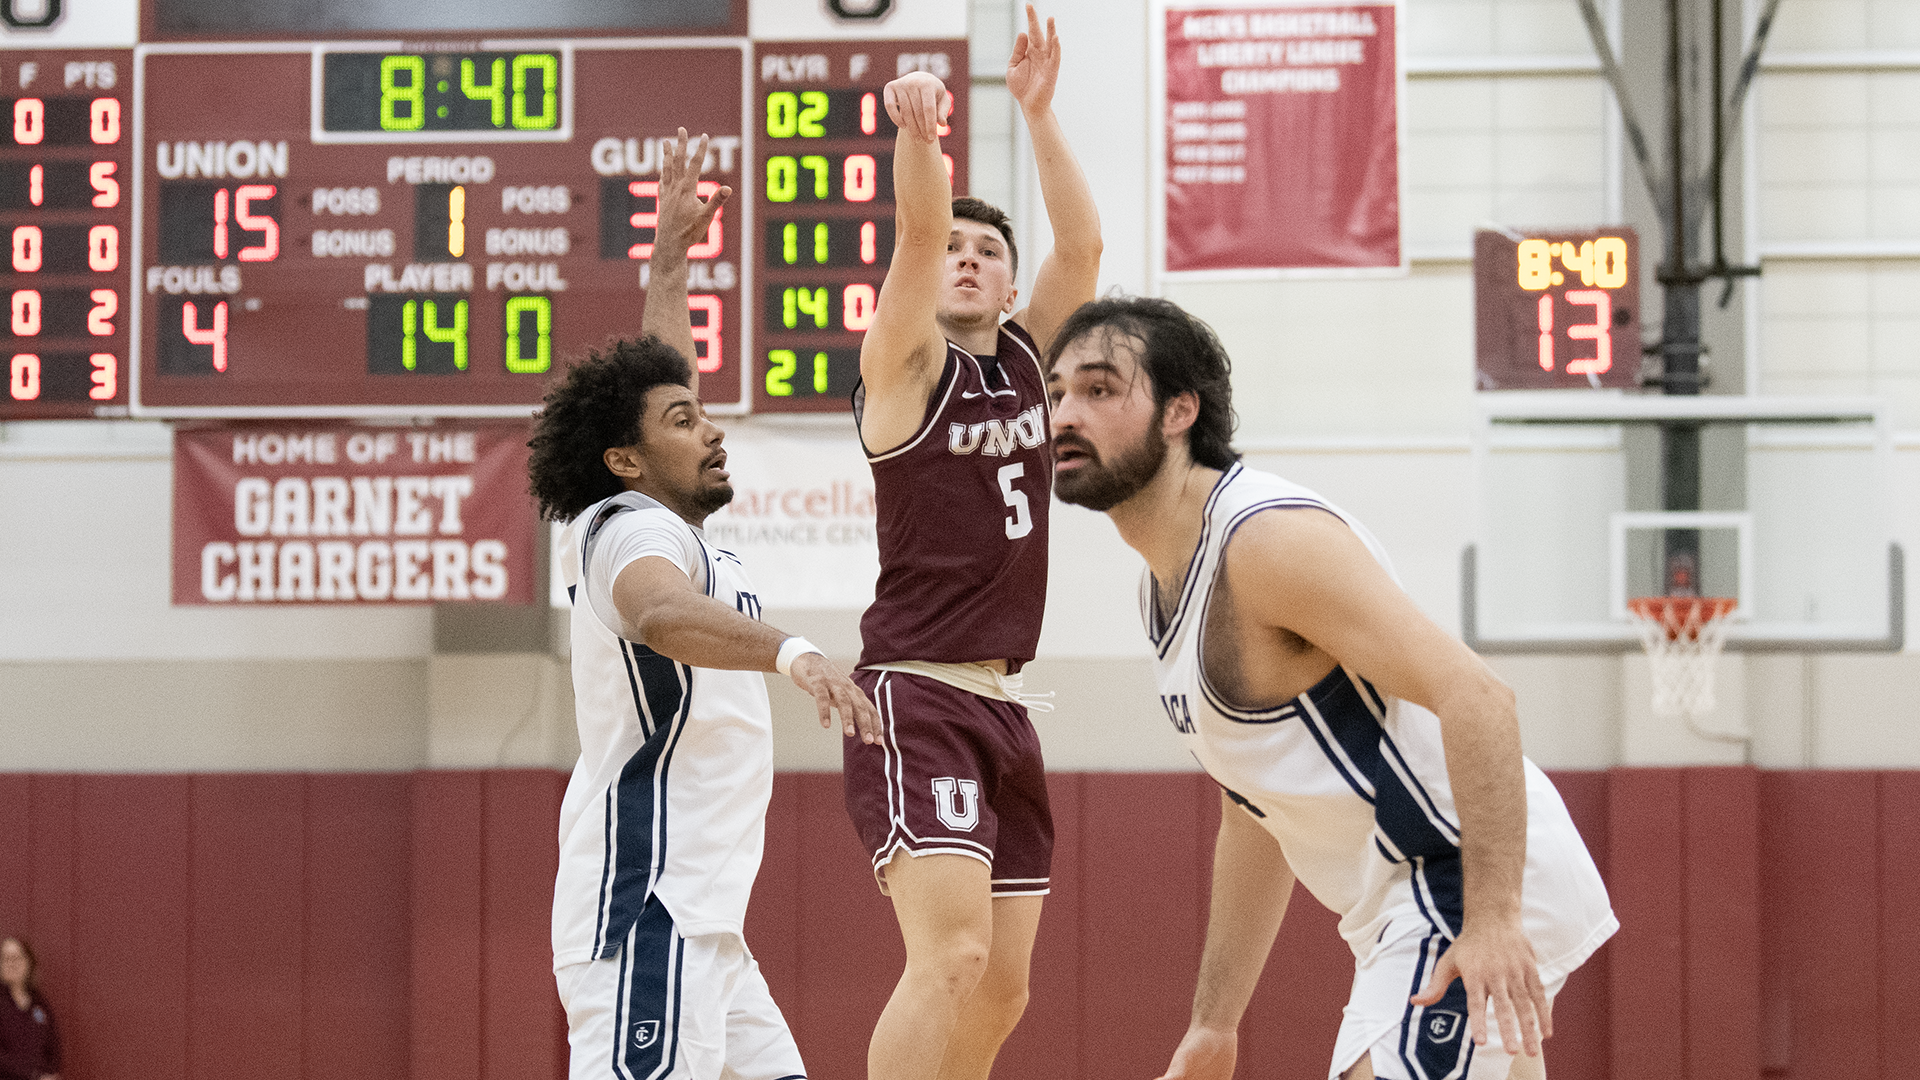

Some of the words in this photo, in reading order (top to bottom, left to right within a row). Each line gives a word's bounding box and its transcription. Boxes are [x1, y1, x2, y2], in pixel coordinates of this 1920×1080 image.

[19, 62, 38, 89] F
[64, 62, 117, 89] PTS
[761, 54, 829, 83] PLYR
[1287, 39, 1366, 65] LEAGUE
[380, 54, 557, 131] 8:40
[1221, 67, 1341, 94] CHAMPIONS
[14, 98, 44, 144] 0
[90, 98, 120, 144] 0
[766, 91, 829, 138] 02
[860, 92, 877, 137] 1
[155, 141, 289, 178] UNION
[387, 156, 496, 185] PERIOD
[766, 155, 829, 202] 07
[843, 154, 876, 202] 0
[29, 164, 44, 206] 1
[89, 161, 120, 208] 5
[311, 188, 381, 215] POSS
[501, 186, 571, 214] POSS
[214, 184, 280, 262] 15
[311, 230, 396, 257] BONUS
[448, 185, 466, 257] 1
[485, 228, 571, 256] BONUS
[783, 222, 828, 264] 11
[860, 221, 876, 264] 1
[12, 225, 42, 272] 0
[89, 225, 119, 272] 0
[1517, 237, 1628, 291] 8:40
[146, 265, 242, 293] FOULS
[364, 263, 473, 292] PLAYER
[486, 262, 568, 292] FOUL
[11, 289, 41, 336] 0
[87, 289, 118, 335] 2
[783, 287, 828, 328] 14
[843, 283, 876, 331] 0
[182, 300, 228, 372] 4
[402, 299, 469, 370] 14
[506, 296, 552, 373] 0
[1538, 290, 1613, 375] 13
[10, 353, 40, 400] 0
[89, 353, 117, 400] 3
[765, 349, 828, 396] 21
[232, 433, 338, 464] HOME
[345, 433, 397, 463] OF
[406, 432, 476, 462] THE
[234, 476, 474, 537] GARNET
[728, 480, 876, 517] arcella
[998, 462, 1033, 540] 5
[200, 540, 509, 601] CHARGERS
[931, 777, 979, 832] U
